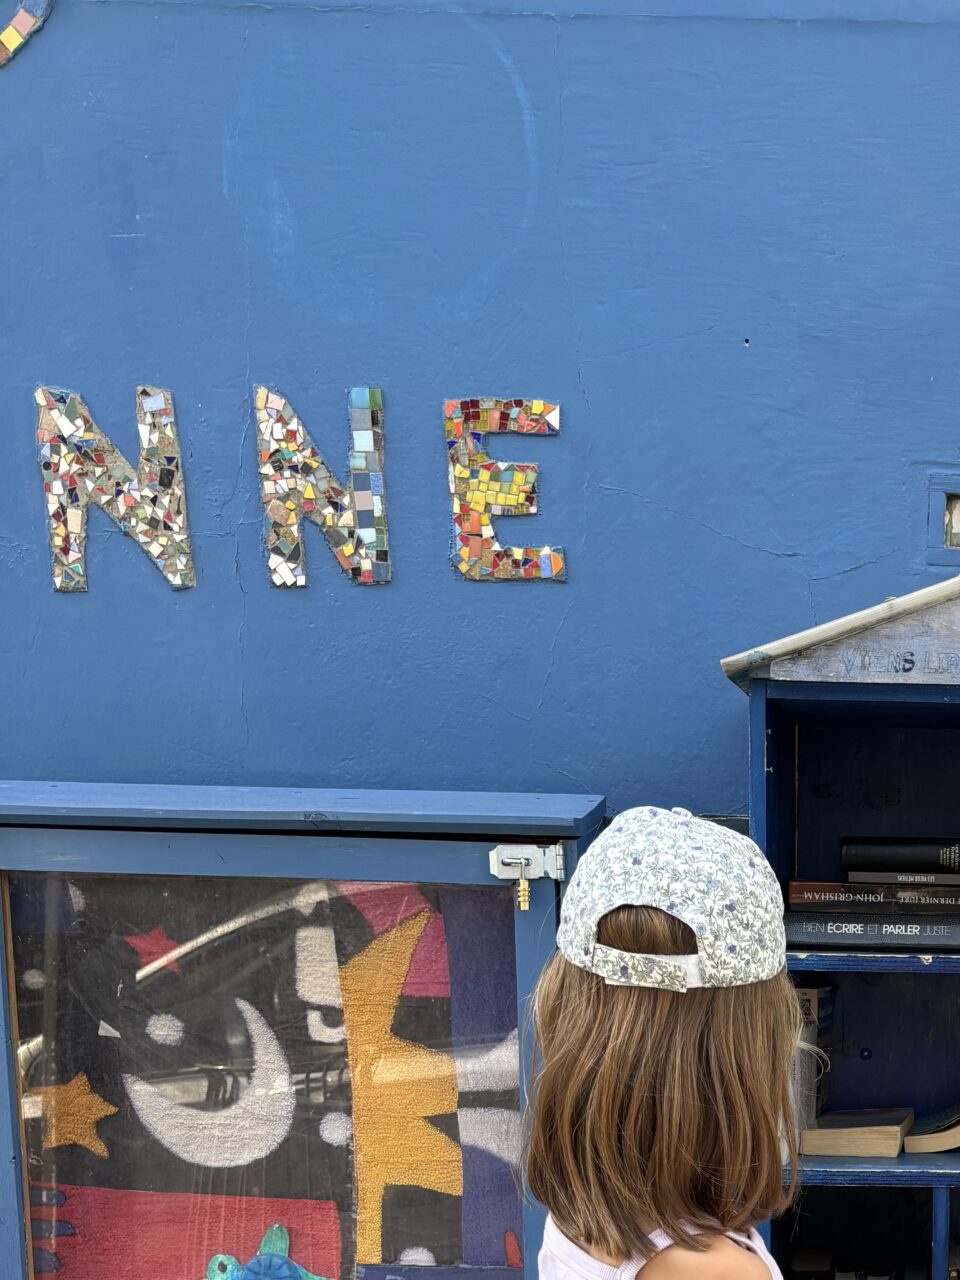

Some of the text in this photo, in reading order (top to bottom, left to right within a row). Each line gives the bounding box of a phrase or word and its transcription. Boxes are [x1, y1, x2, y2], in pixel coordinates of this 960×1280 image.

[842, 650, 915, 677] VIENS
[803, 890, 883, 903] JOHN GRISHAM
[920, 896, 955, 905] DERNIER
[868, 925, 878, 934] ET
[882, 925, 921, 936] PARLER
[923, 926, 951, 936] JUSTE
